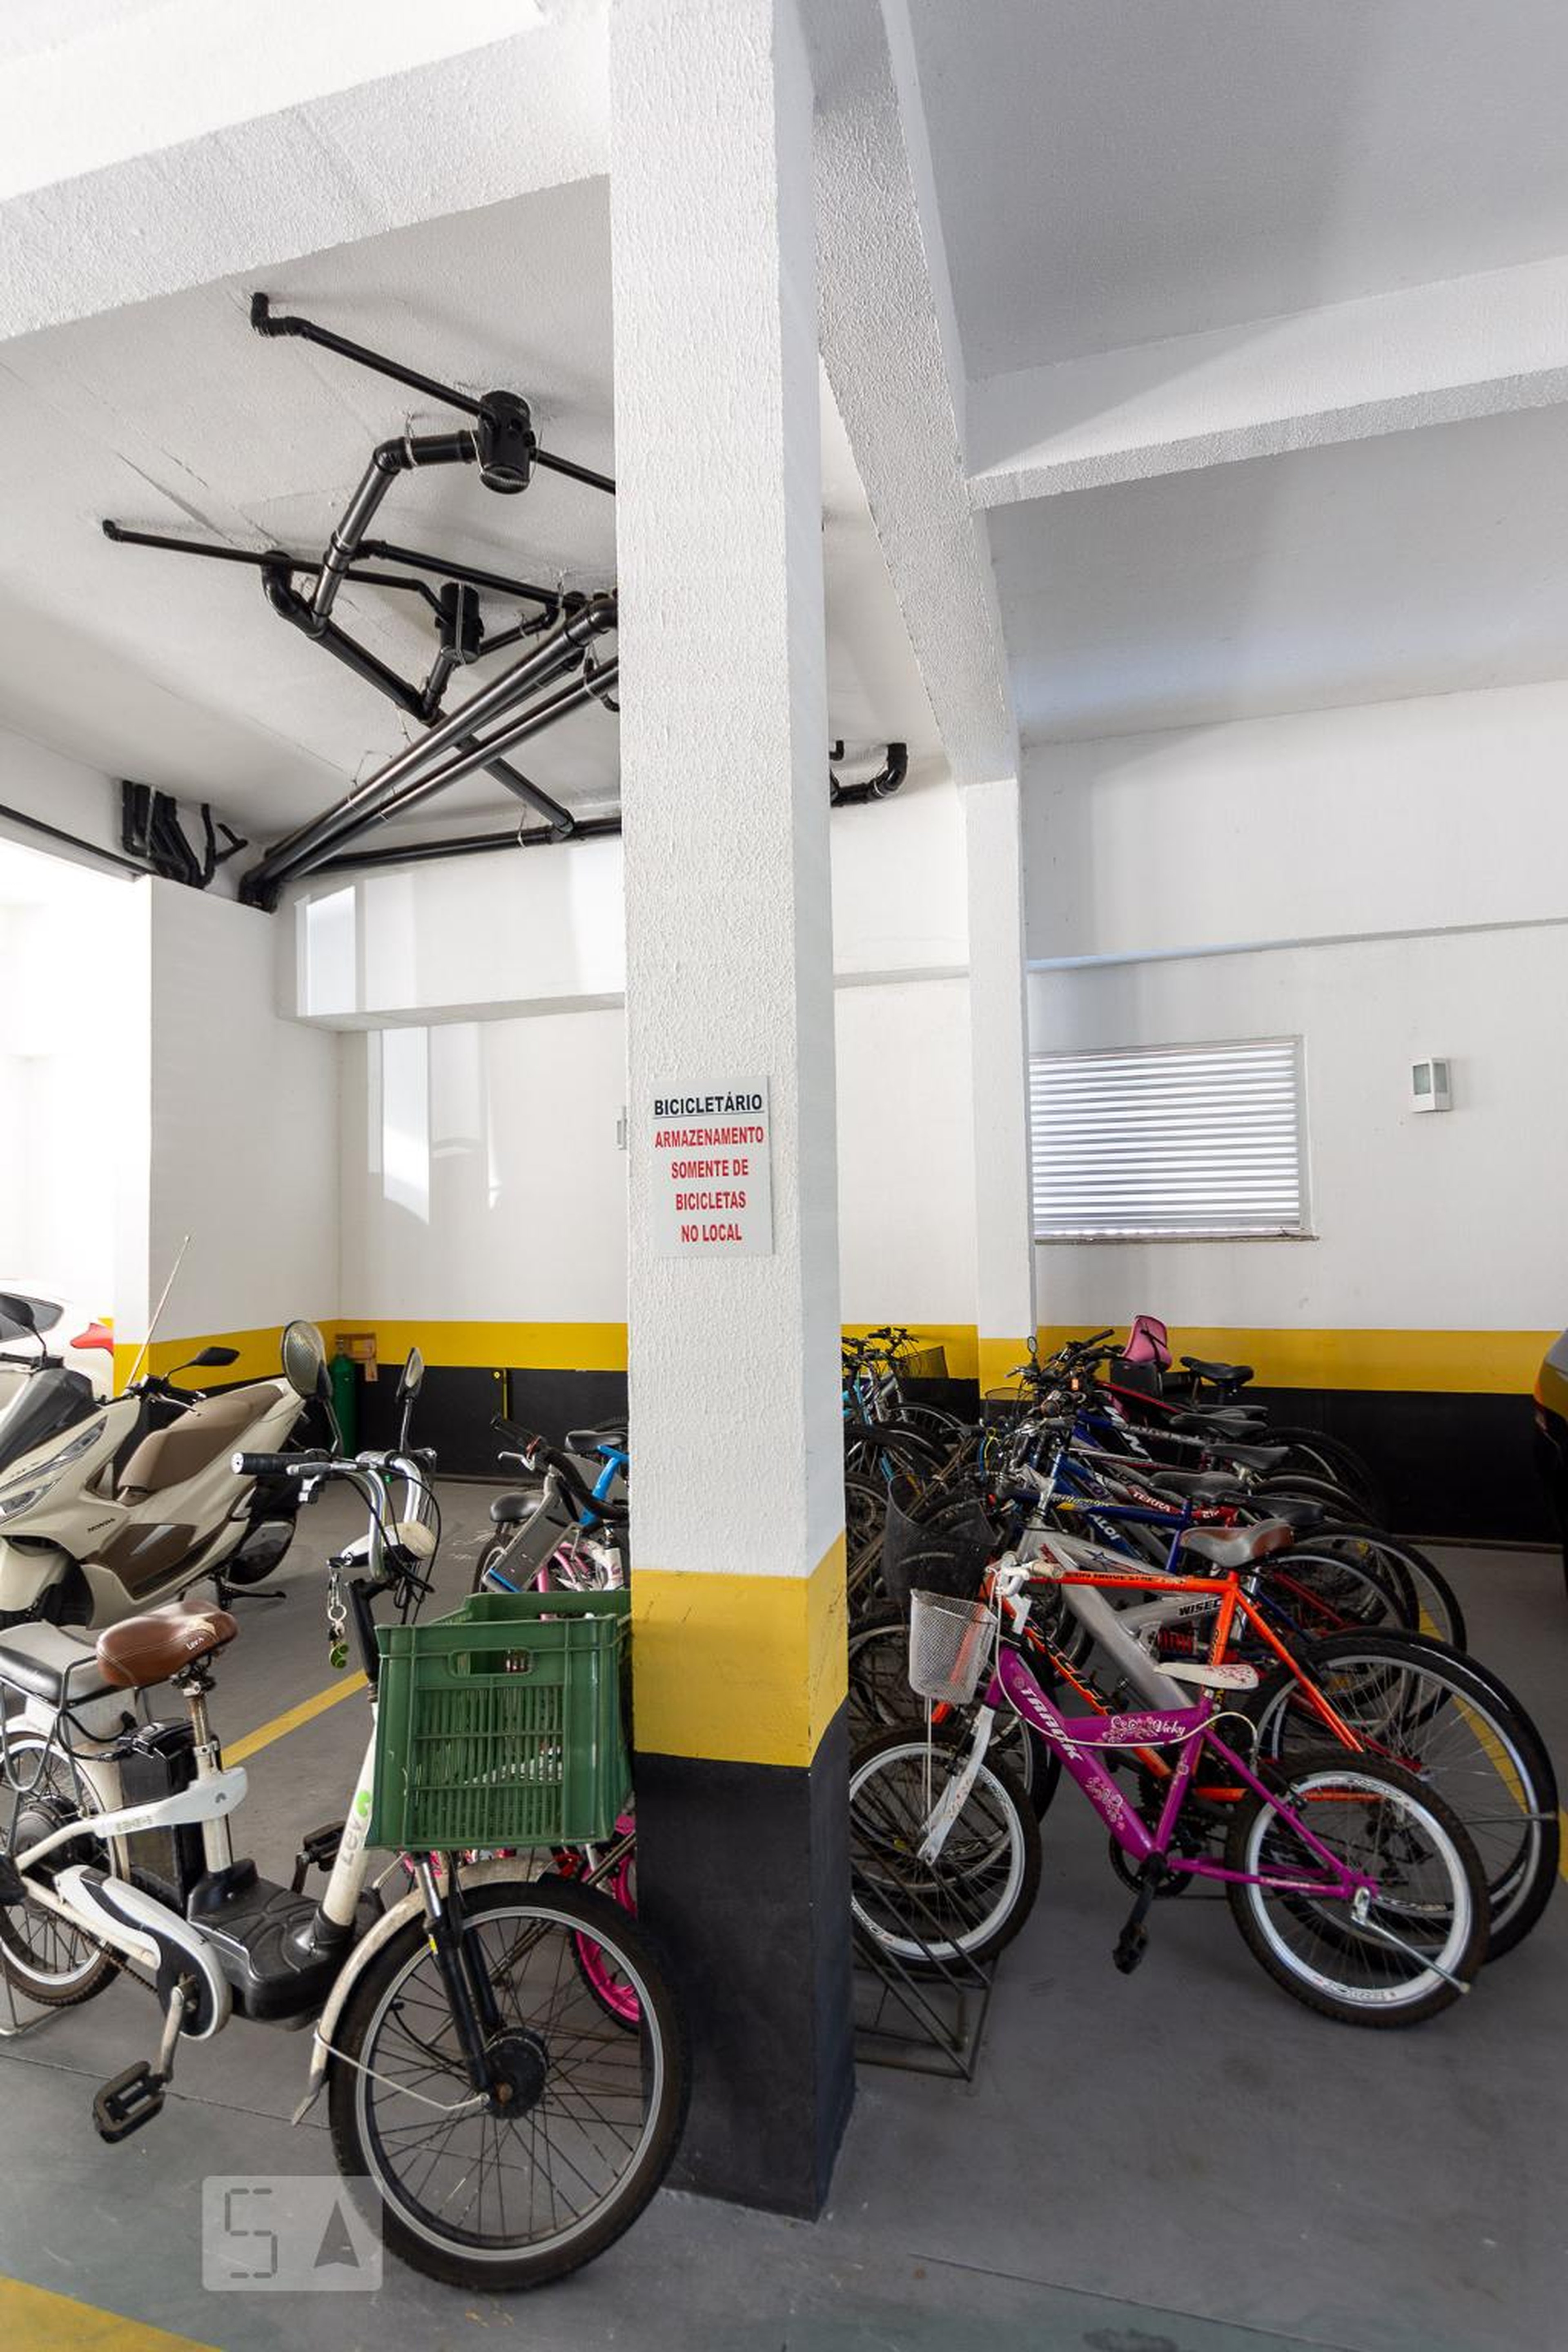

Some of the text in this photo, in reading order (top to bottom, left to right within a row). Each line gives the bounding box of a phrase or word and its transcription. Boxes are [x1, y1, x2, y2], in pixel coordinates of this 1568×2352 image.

[654, 1092, 762, 1115] BICICLETÁRIO
[655, 1127, 764, 1148] ARMAZENAMENTO
[671, 1159, 748, 1178] SOMENTE DE
[676, 1191, 746, 1210] BICICLETAS
[682, 1224, 742, 1242] NO LOCAL
[1089, 1514, 1121, 1540] ALOI
